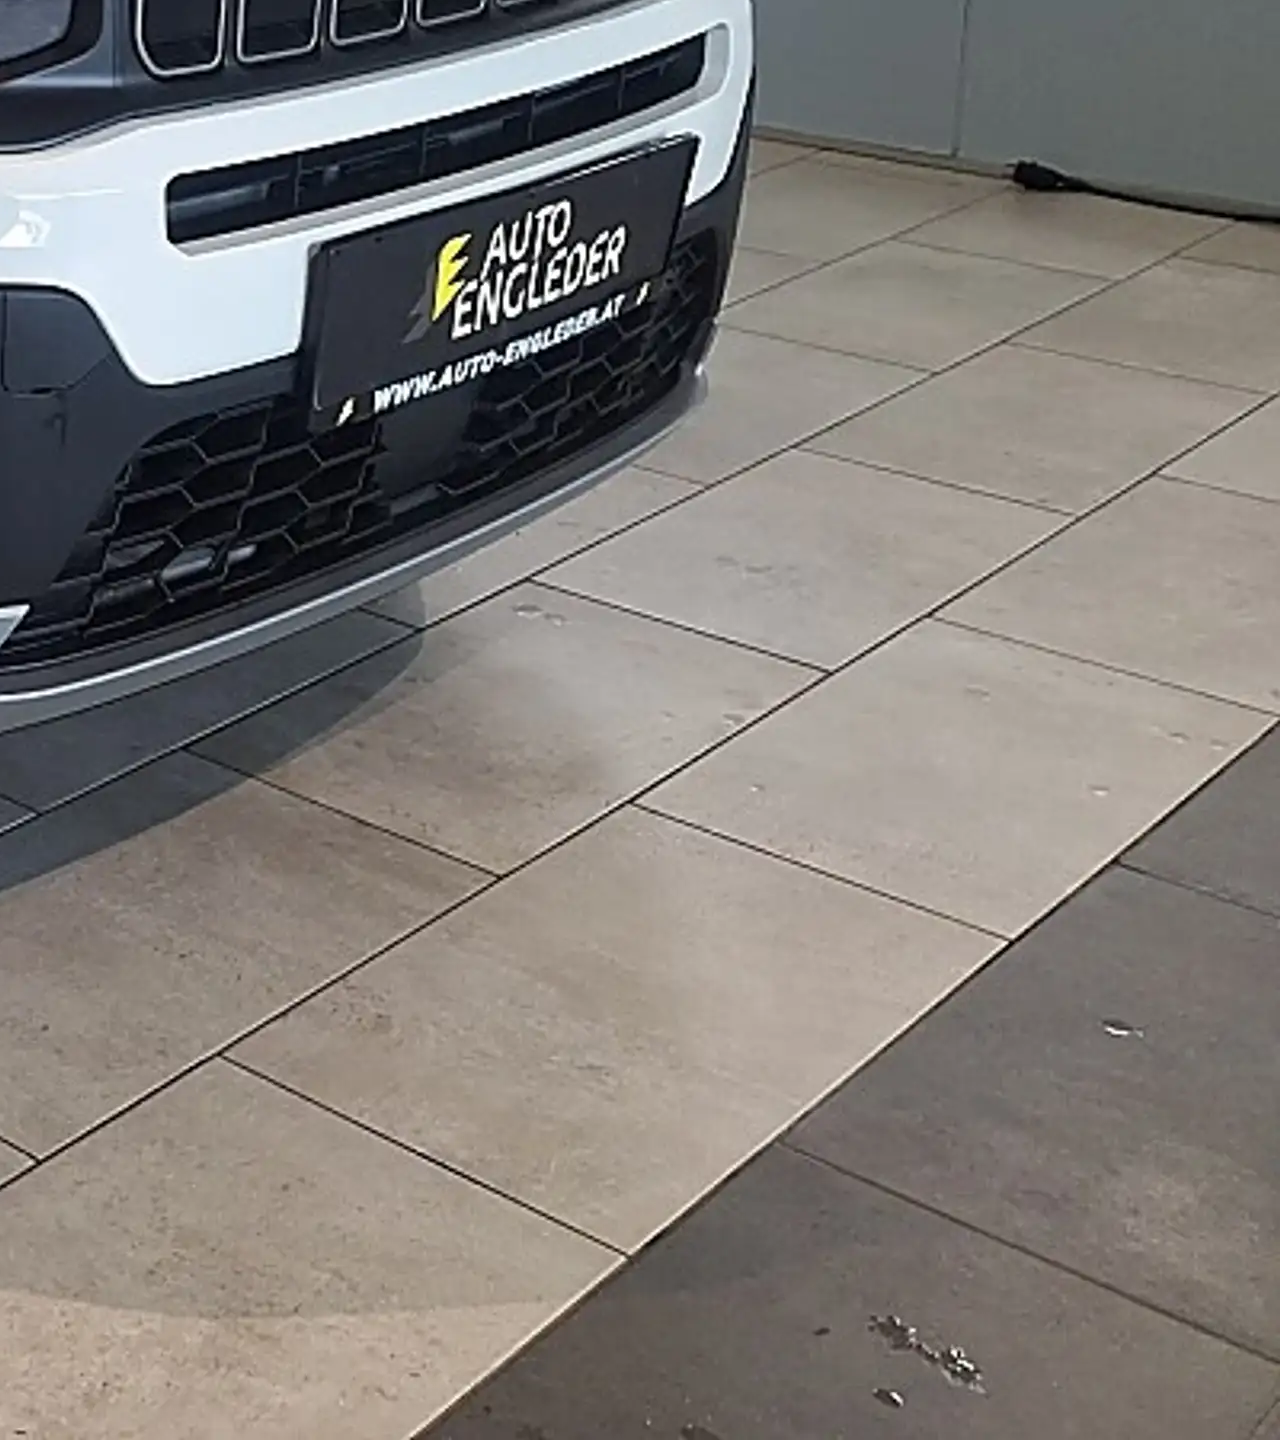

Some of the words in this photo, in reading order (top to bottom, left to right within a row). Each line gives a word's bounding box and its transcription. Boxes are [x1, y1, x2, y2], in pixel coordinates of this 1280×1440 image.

[449, 224, 627, 340] ENGLEDER
[482, 198, 572, 278] AUTO
[373, 293, 626, 413] WWW.AUTO-ENGLEDER.AT
